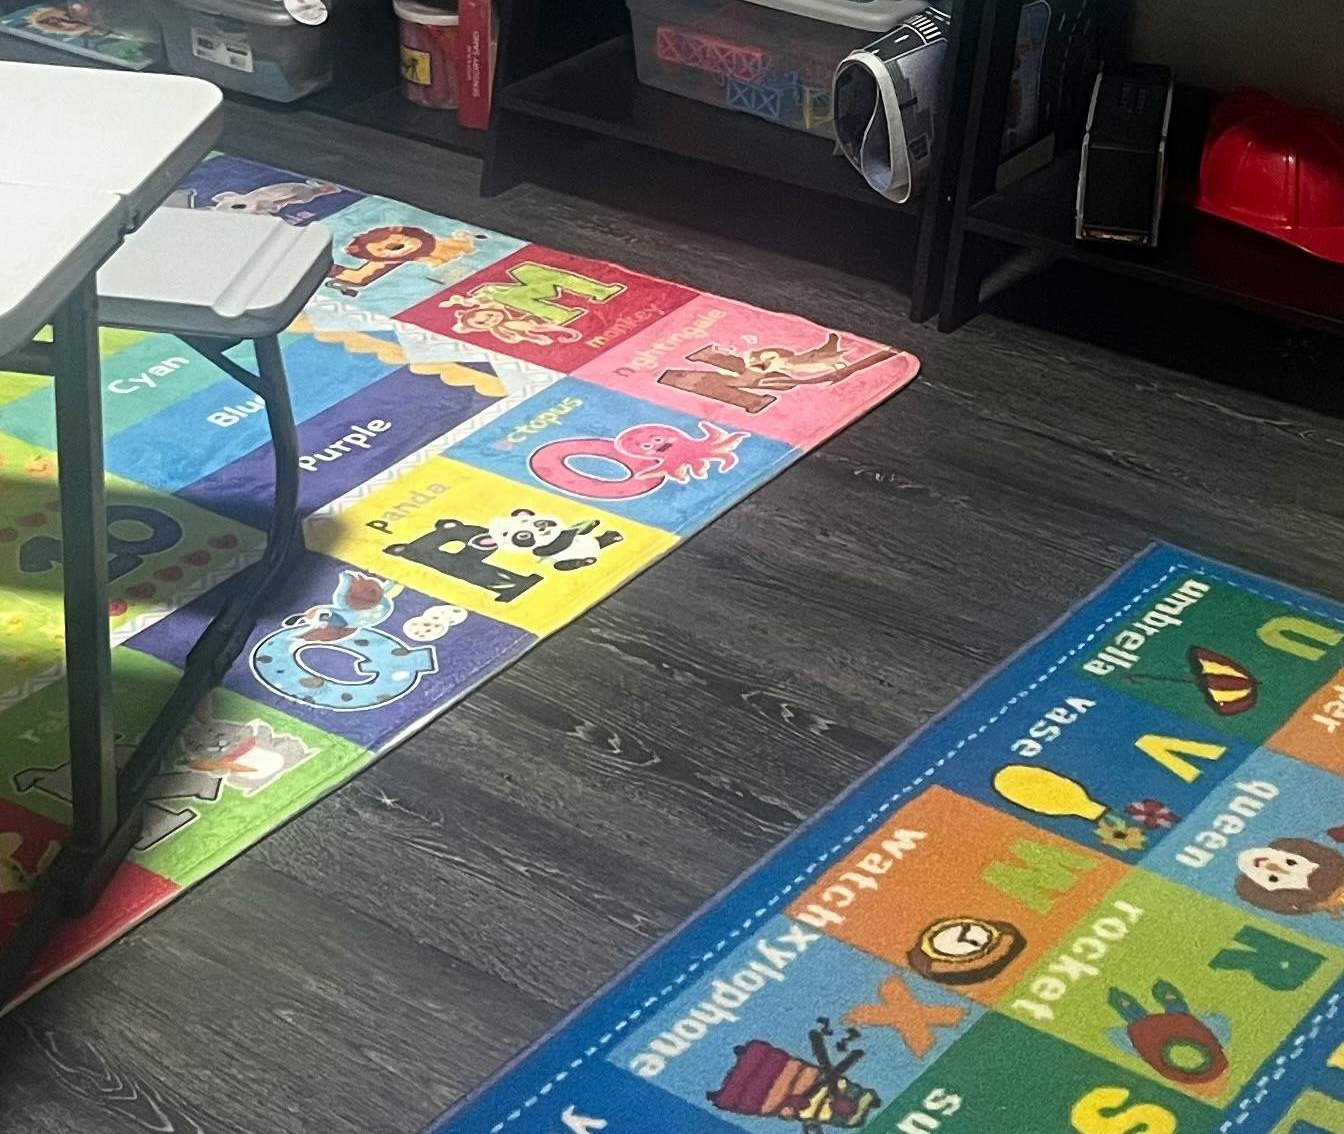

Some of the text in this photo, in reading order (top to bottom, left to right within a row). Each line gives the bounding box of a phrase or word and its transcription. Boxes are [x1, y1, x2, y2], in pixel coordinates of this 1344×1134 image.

[469, 261, 627, 326] M
[587, 307, 665, 350] monkey
[611, 309, 729, 378] nightingale
[107, 353, 191, 397] Cyan
[656, 344, 779, 415] N
[207, 395, 265, 429] Blu
[299, 415, 394, 474] Purple
[494, 395, 583, 451] octopus
[529, 437, 666, 501] O
[366, 481, 451, 536] panda
[1083, 579, 1211, 679] umbrella
[249, 624, 439, 712] Q
[1011, 694, 1097, 760] vase
[1134, 732, 1228, 784] V
[1175, 779, 1280, 869] queen
[798, 827, 929, 930] watch
[982, 837, 1100, 913] W
[1011, 899, 1145, 1022] rocket
[1208, 924, 1330, 992] R
[629, 922, 823, 1080] xylophone
[841, 975, 972, 1059] X
